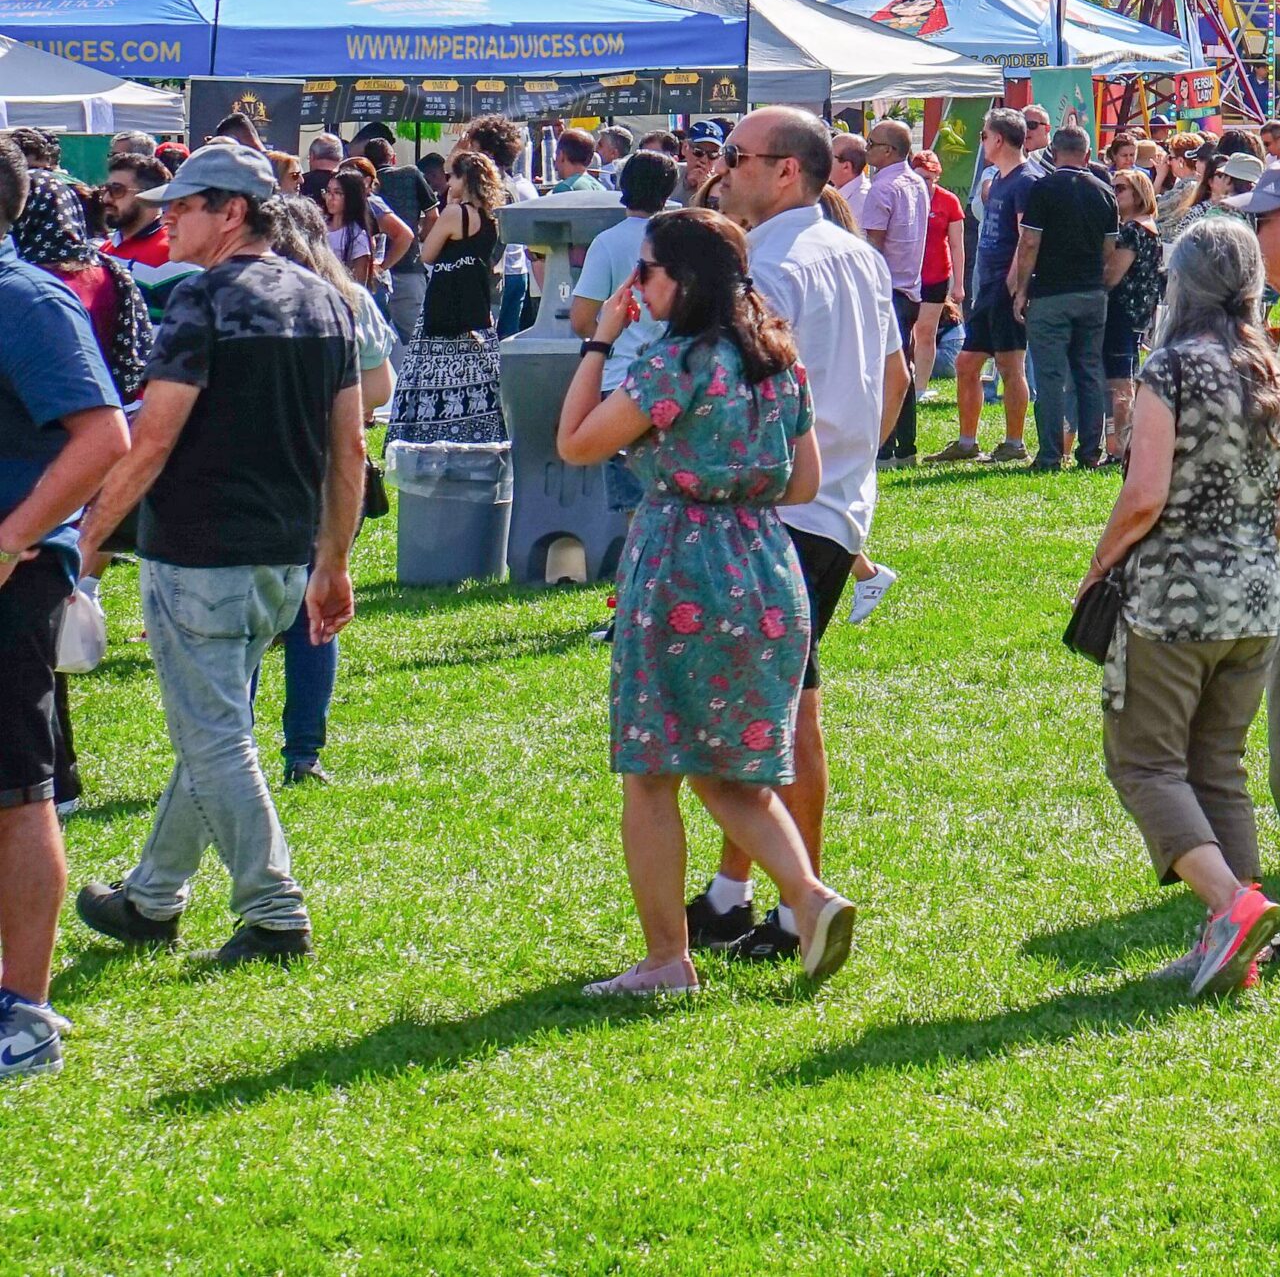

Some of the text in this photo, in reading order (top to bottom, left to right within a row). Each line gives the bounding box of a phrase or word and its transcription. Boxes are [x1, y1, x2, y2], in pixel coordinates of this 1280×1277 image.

[346, 33, 625, 61] WWW.IMPERIALJUICES.COM
[970, 53, 1049, 68] OODEH
[1193, 76, 1214, 90] PERSIA
[1196, 89, 1212, 102] LADY
